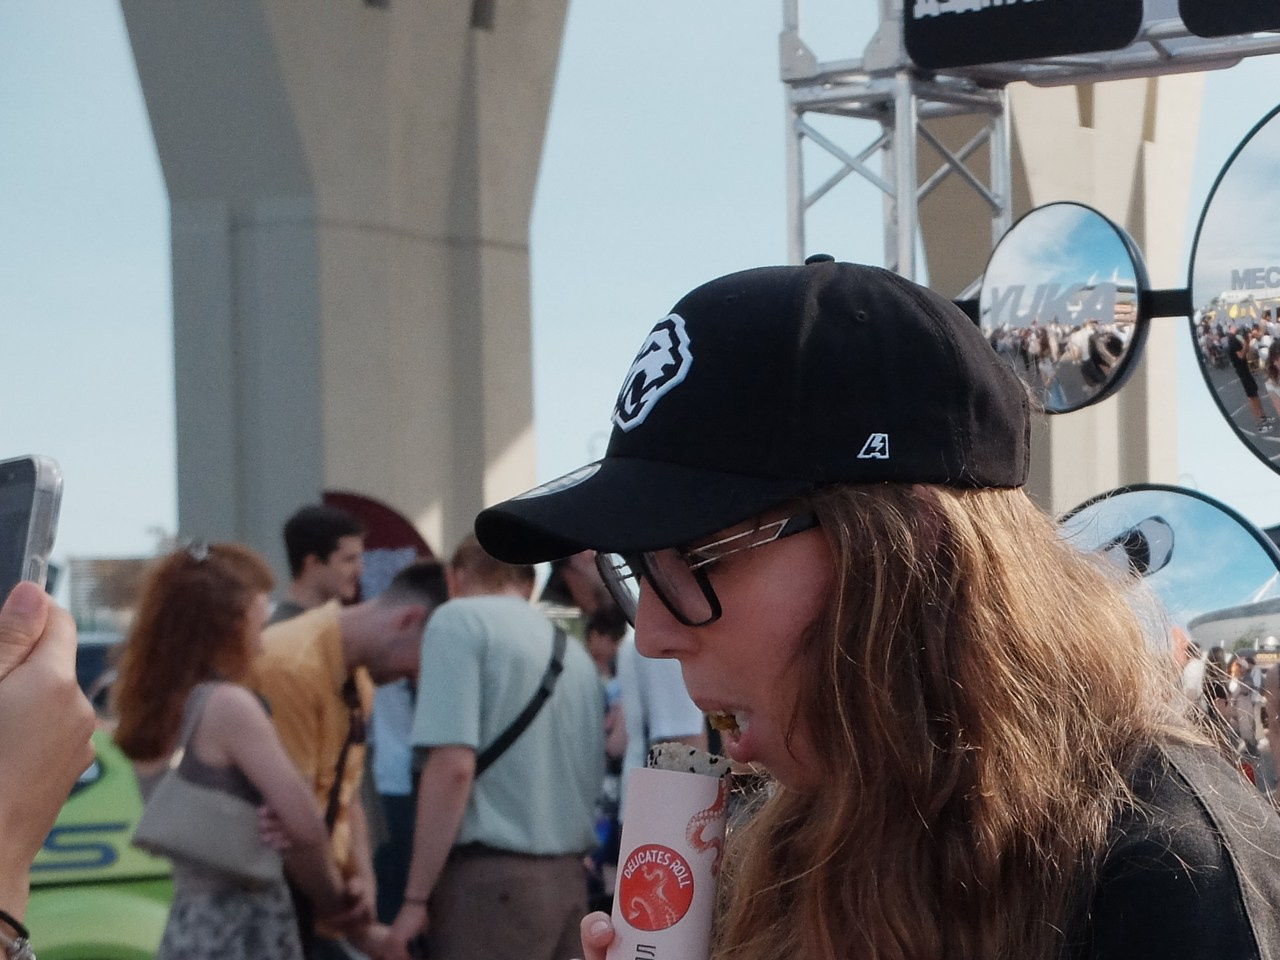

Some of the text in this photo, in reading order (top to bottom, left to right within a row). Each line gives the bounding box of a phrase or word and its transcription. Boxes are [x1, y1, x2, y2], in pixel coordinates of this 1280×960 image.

[990, 282, 1118, 329] YUKA
[623, 850, 691, 889] DELICATES ROLL
